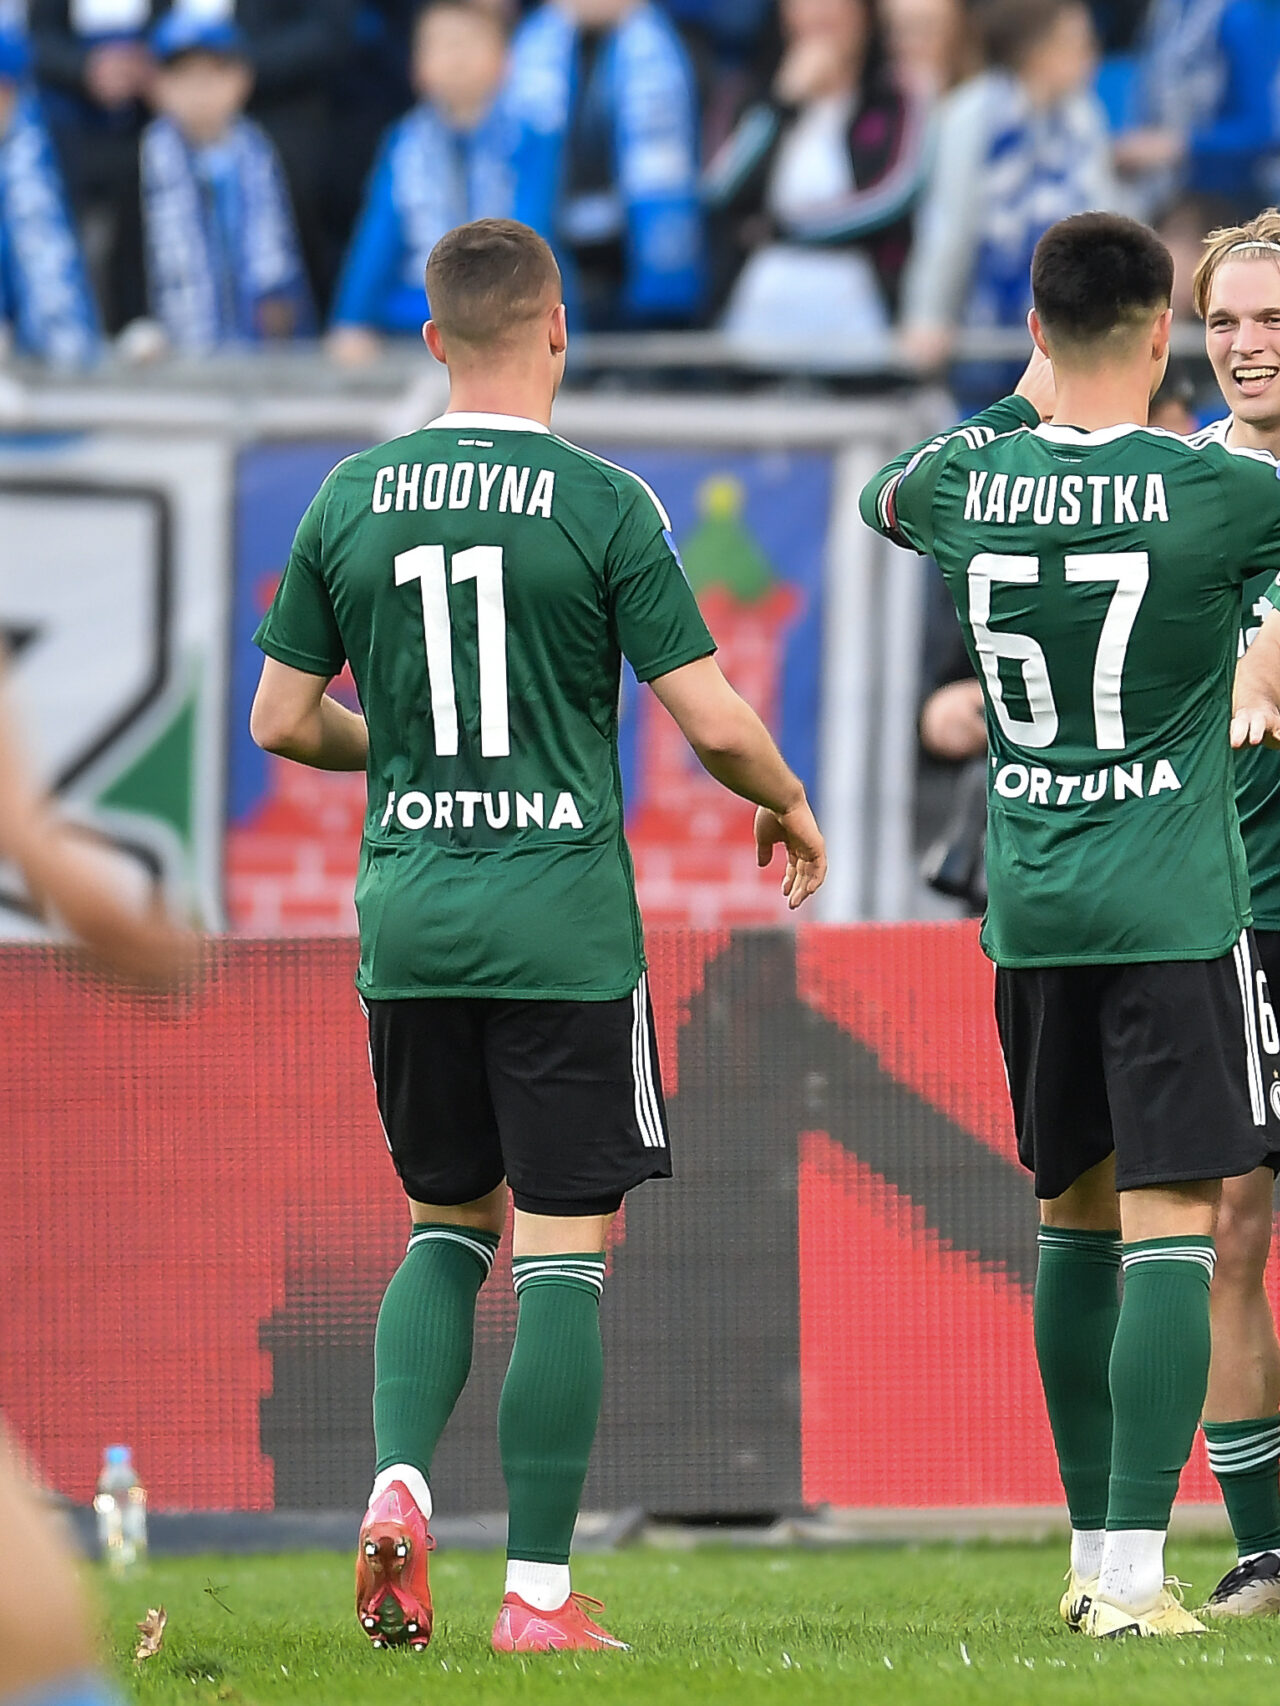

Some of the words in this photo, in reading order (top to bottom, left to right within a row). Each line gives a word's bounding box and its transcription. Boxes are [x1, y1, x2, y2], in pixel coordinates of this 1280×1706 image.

[372, 461, 555, 519] CHODYNA
[963, 473, 1170, 526] KAPUSTKA
[394, 544, 511, 758] 11
[967, 551, 1150, 750] 67
